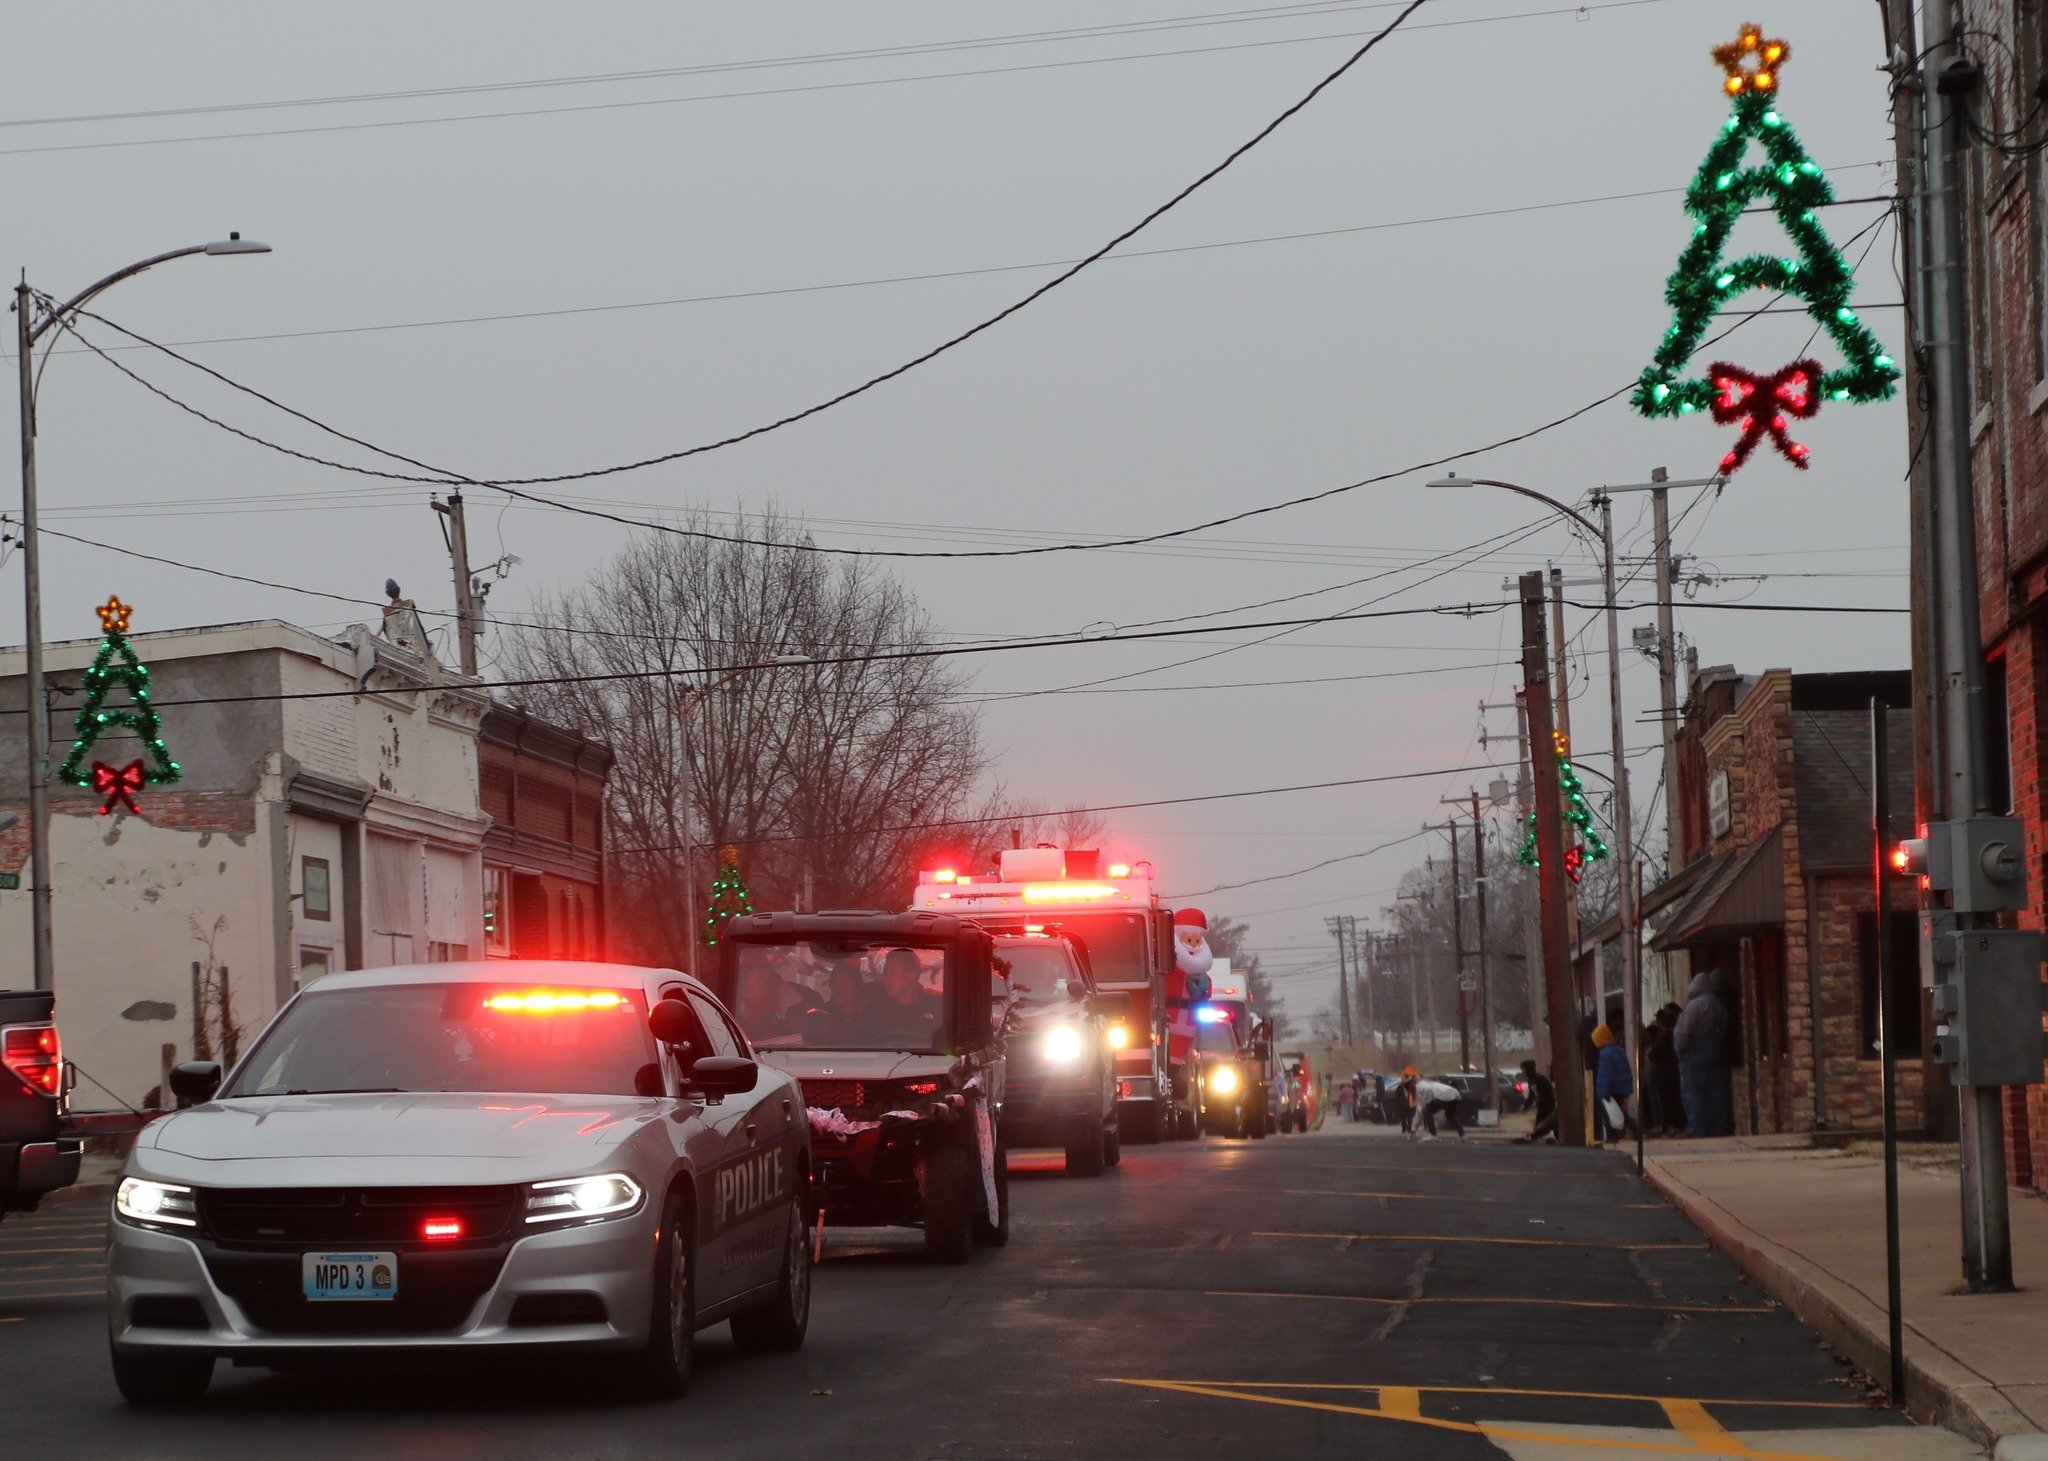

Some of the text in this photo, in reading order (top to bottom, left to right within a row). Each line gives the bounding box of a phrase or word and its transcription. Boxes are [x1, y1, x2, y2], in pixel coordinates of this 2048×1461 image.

[720, 1147, 784, 1222] POLICE
[316, 1265, 365, 1290] MPD 3
